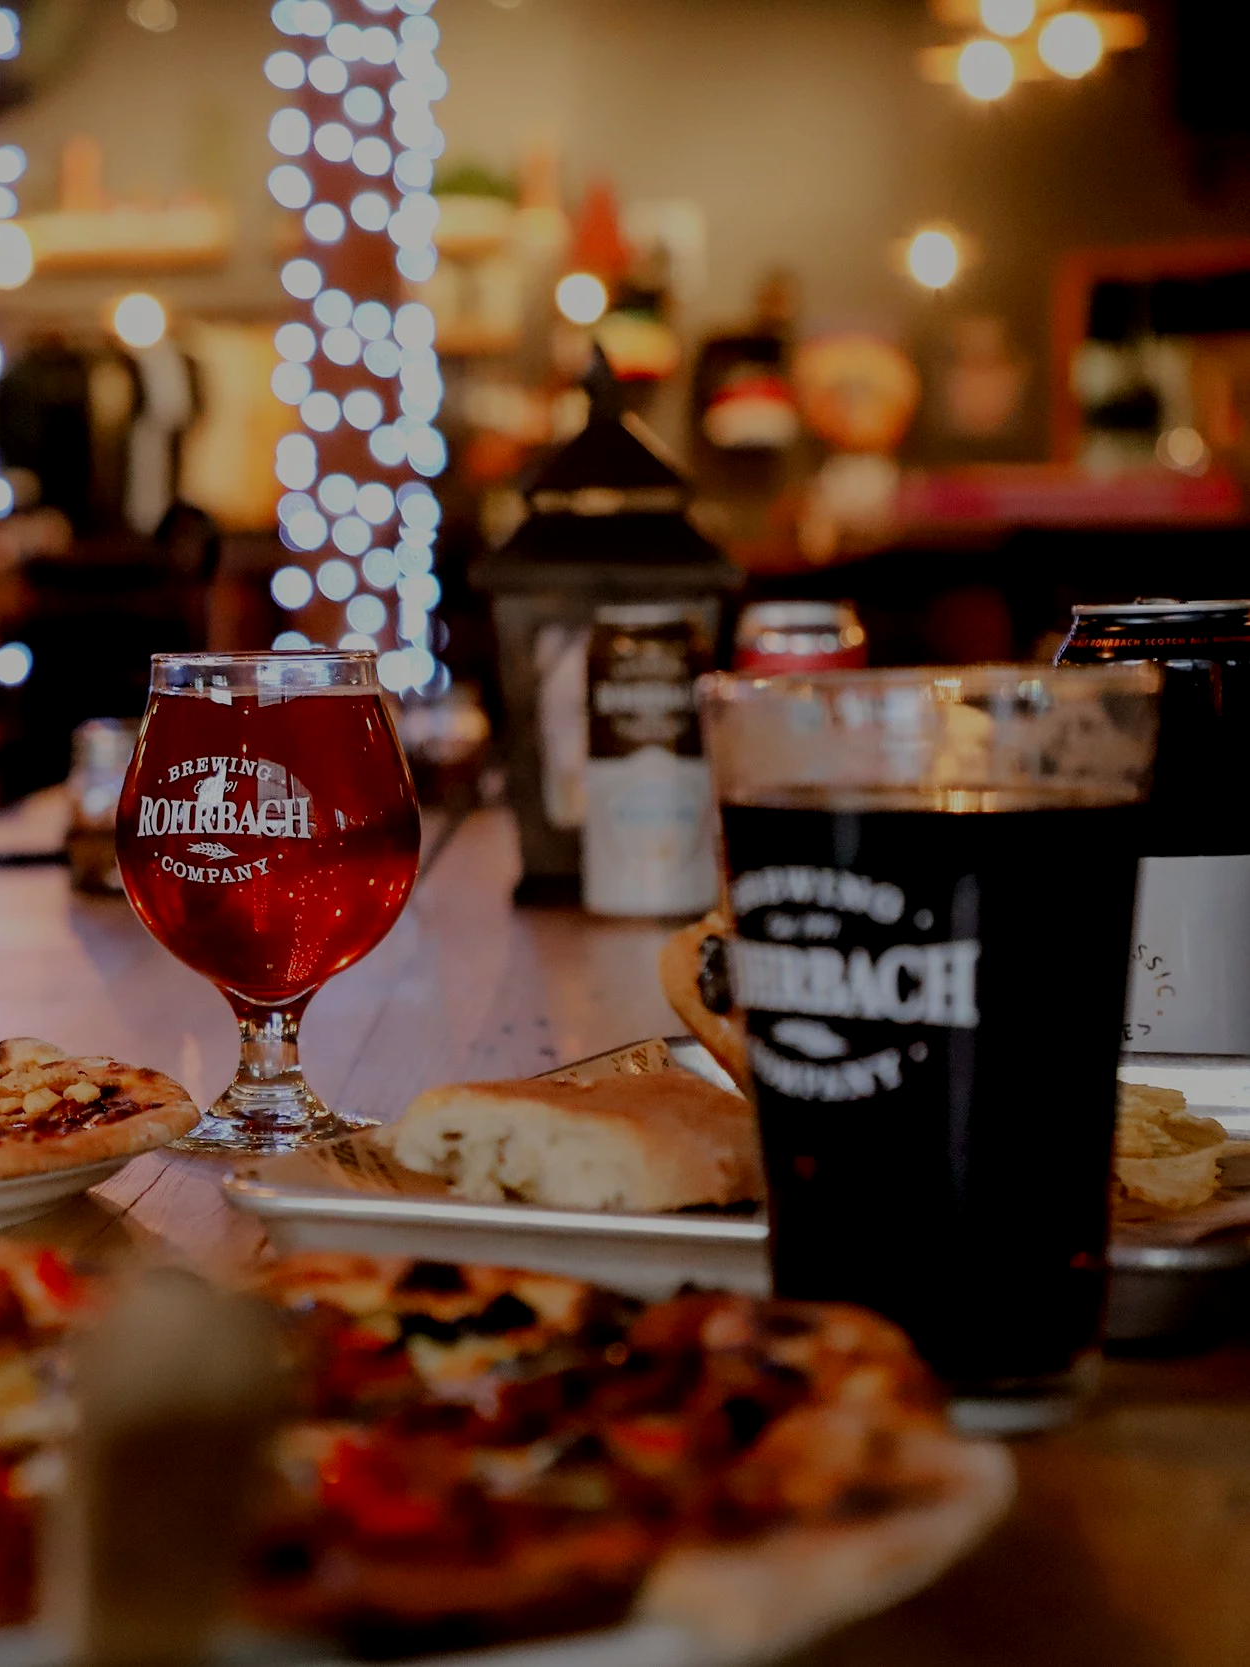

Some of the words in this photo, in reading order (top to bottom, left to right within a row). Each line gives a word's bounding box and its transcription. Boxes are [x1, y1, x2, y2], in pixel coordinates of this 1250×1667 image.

[1144, 637, 1186, 646] SCOTCH
[168, 756, 273, 783] BREWING
[137, 796, 312, 839] ROHRBACH
[161, 855, 270, 883] COMPANY
[1132, 943, 1176, 998] SSIC
